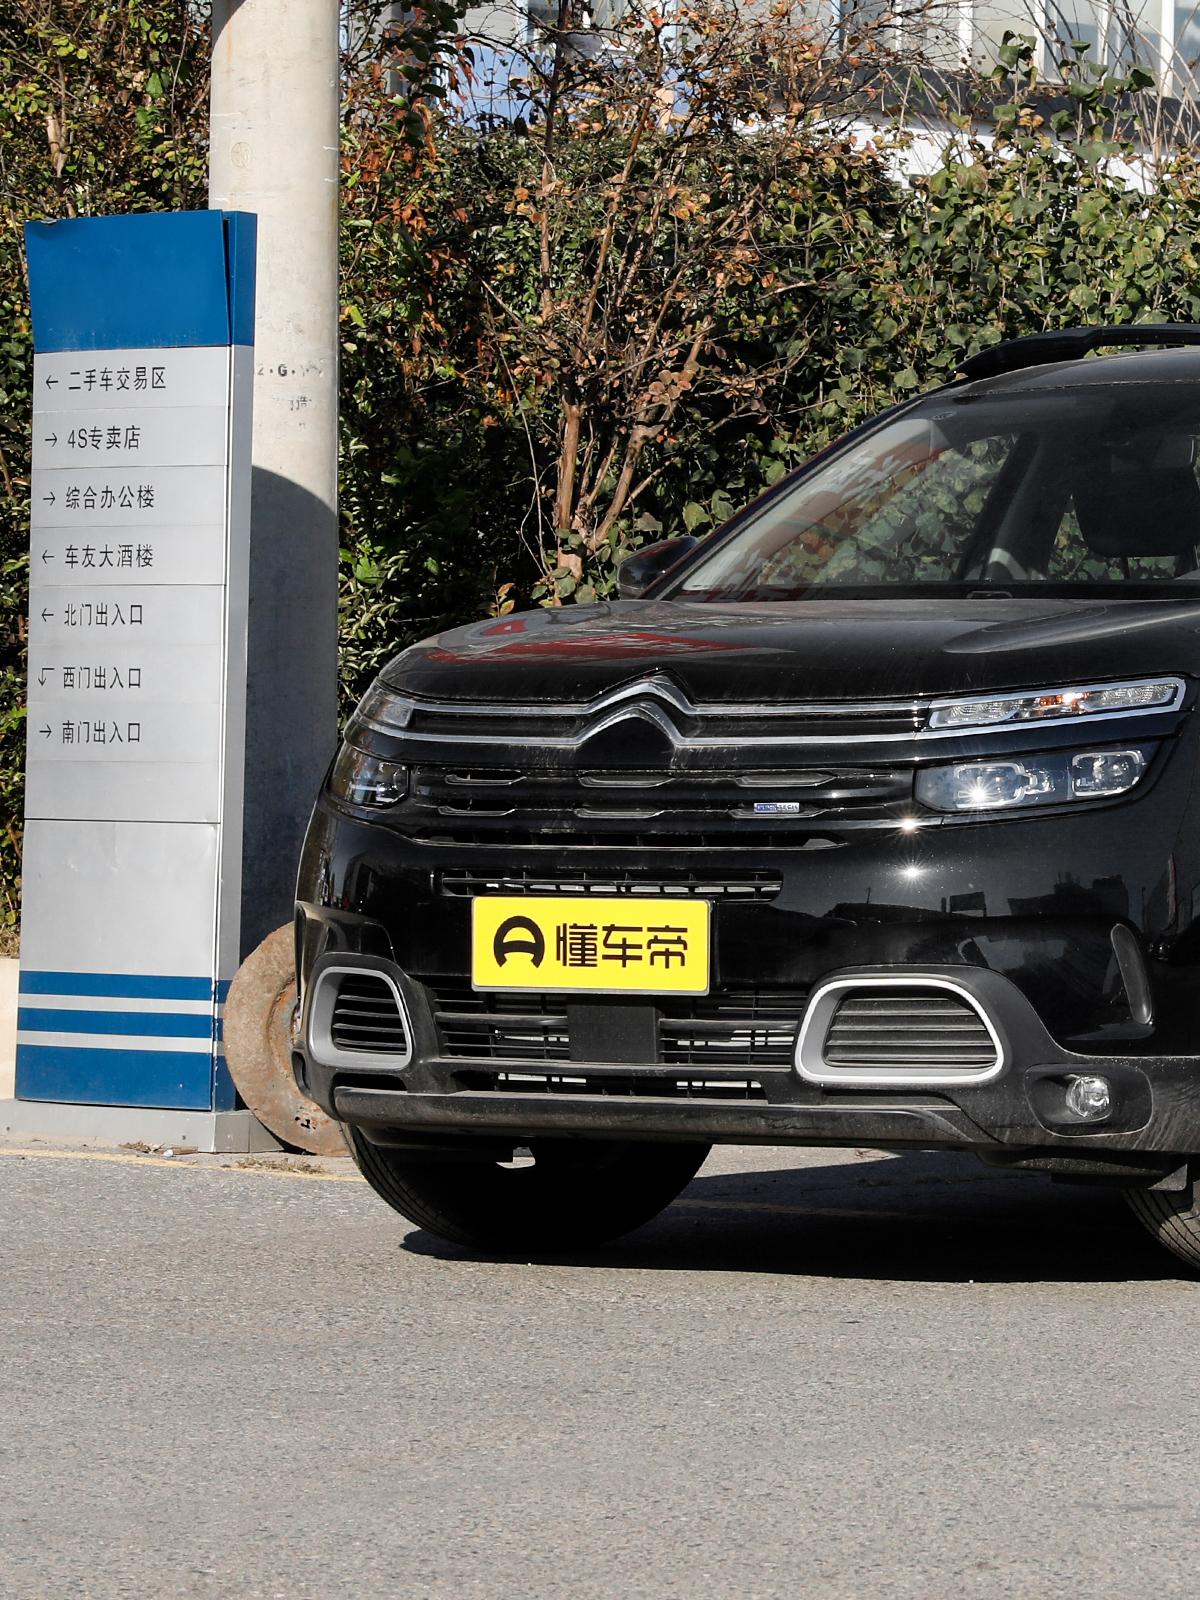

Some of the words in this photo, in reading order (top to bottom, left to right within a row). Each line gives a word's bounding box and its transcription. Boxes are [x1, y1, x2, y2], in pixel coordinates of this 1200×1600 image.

[68, 366, 167, 391] 二手车交易区
[67, 425, 141, 450] 4S专卖店
[65, 485, 155, 510] 综合办公楼
[64, 544, 154, 569] 车友大酒楼
[64, 603, 143, 627] 北门出入口
[62, 666, 141, 689] 西门出入口
[62, 720, 141, 744] 南门出入口
[556, 923, 688, 969] 懂车帝
